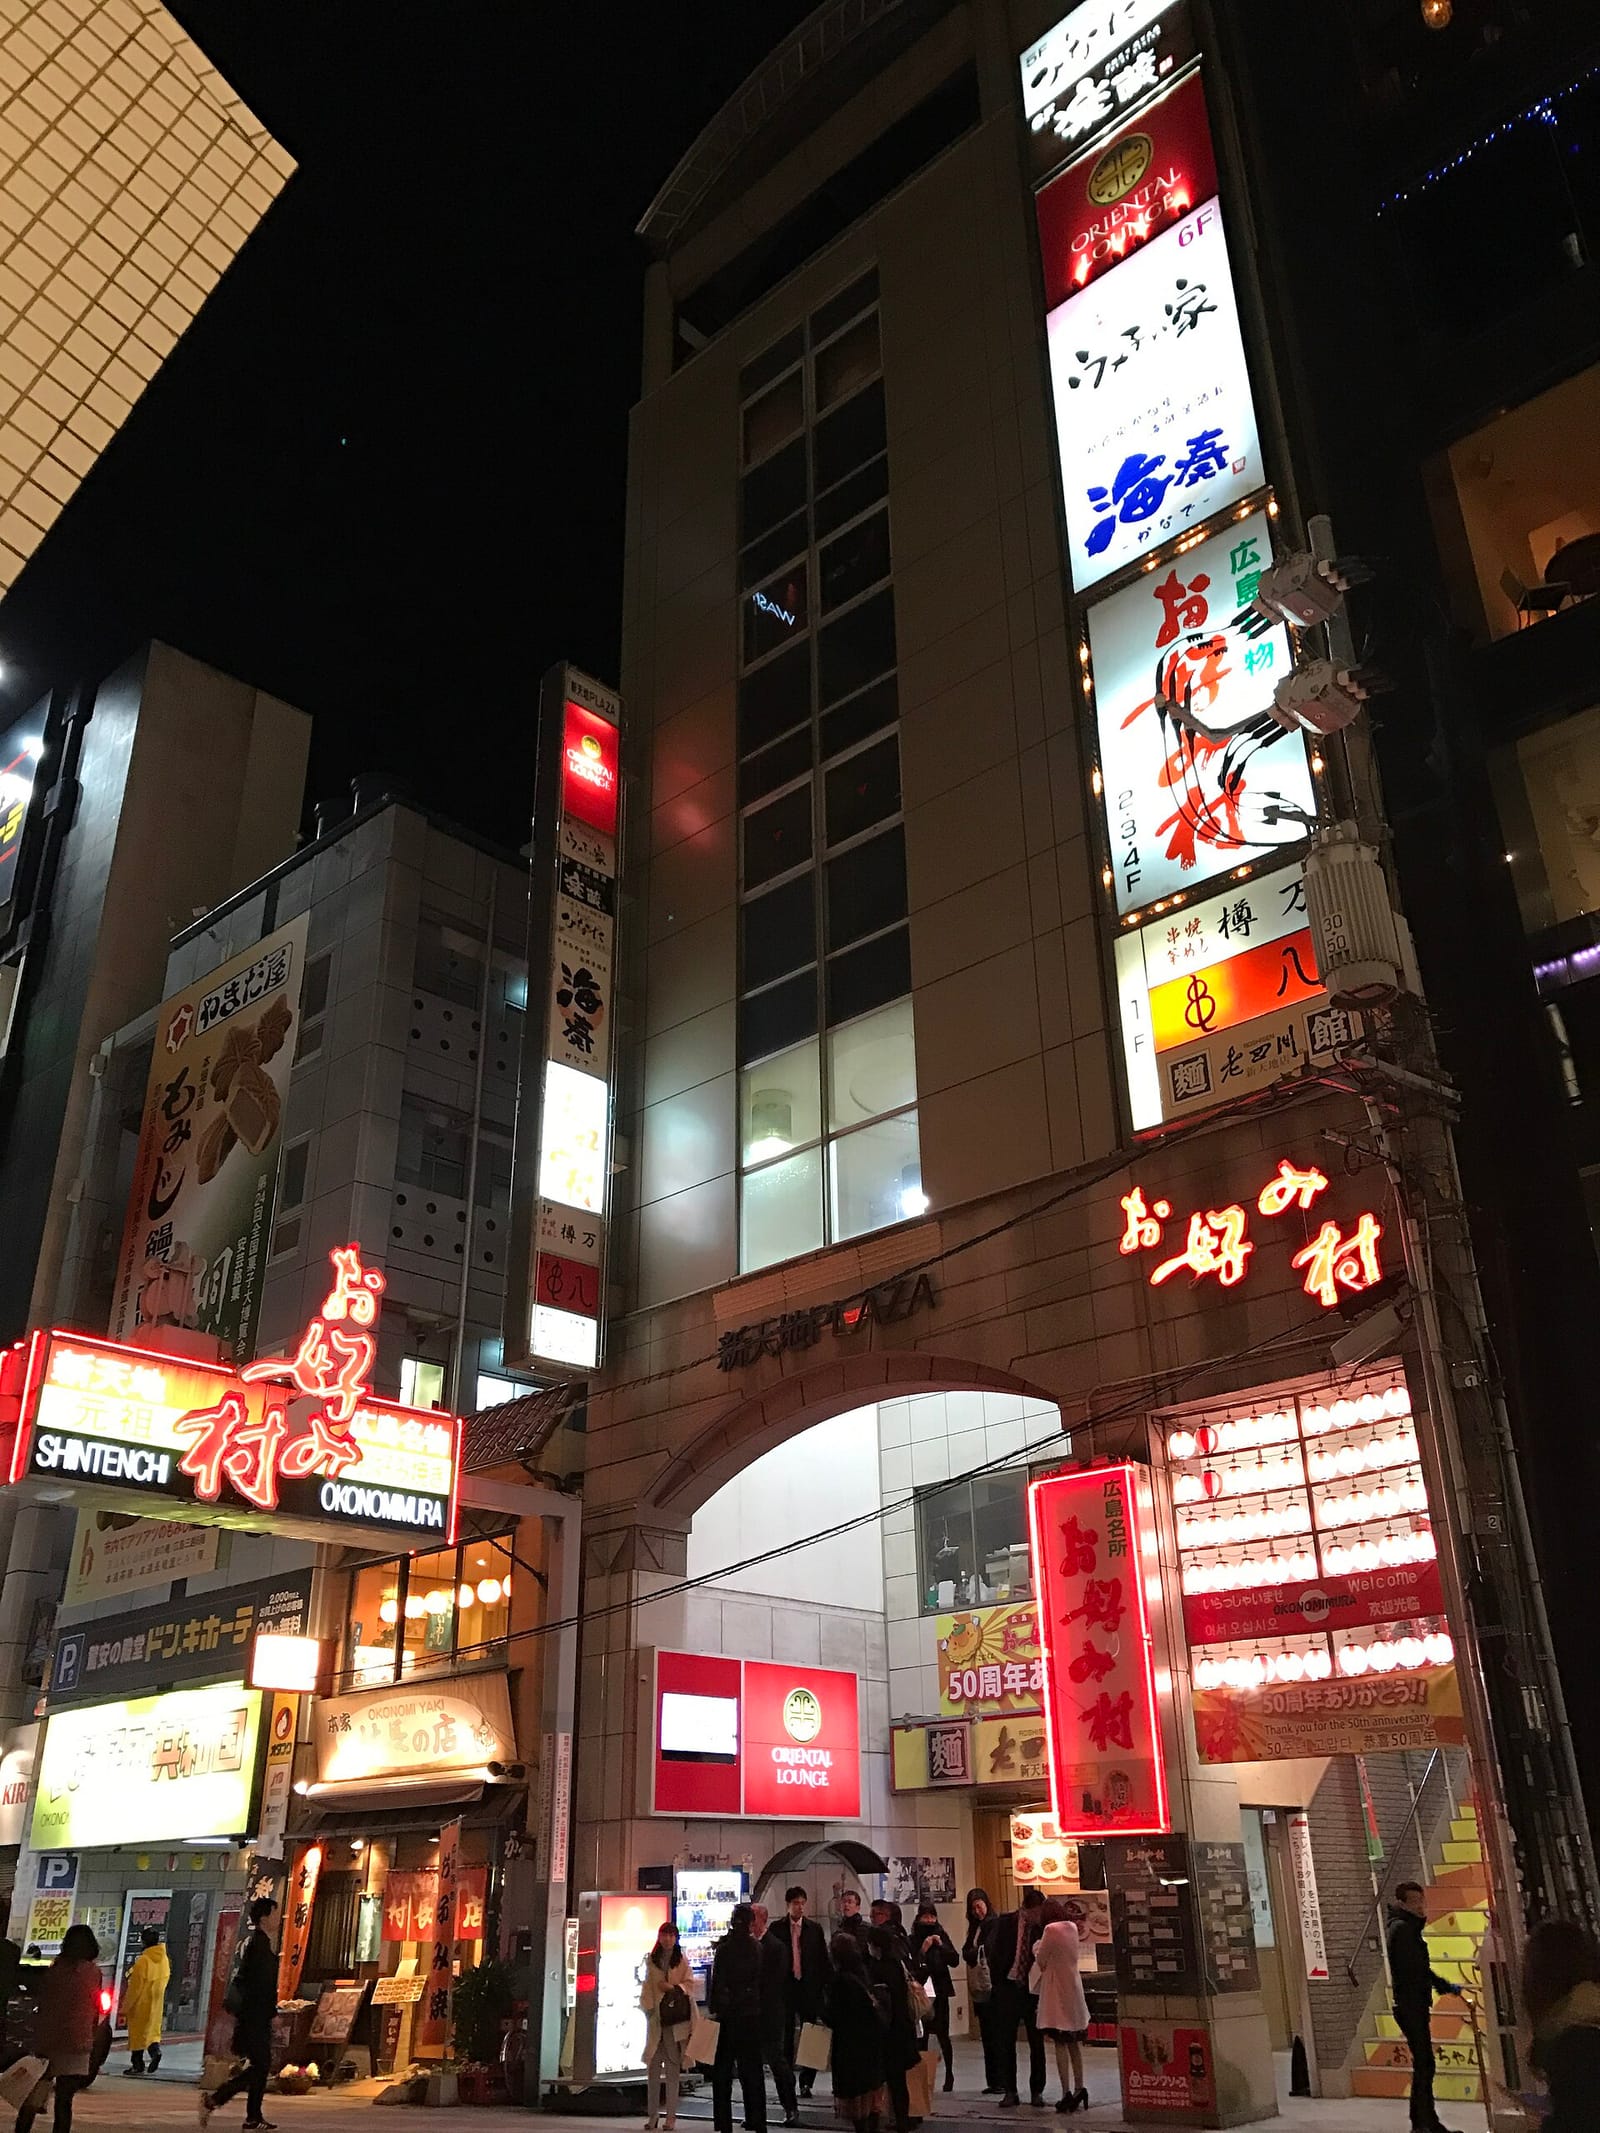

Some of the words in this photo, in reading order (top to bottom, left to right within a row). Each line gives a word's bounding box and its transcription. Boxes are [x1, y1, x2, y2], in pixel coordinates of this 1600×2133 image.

[1071, 168, 1181, 253] ORIENTAL
[1178, 207, 1214, 247] 6F
[1230, 537, 1275, 677] 広島物
[1118, 1158, 1382, 1308] お好み村
[1104, 1480, 1127, 1557] 広島名所
[1202, 1589, 1284, 1611] いらっしゃいませ
[1273, 1595, 1357, 1615] OKONOMIMURA
[1058, 1515, 1135, 1752] お好み村
[368, 1706, 417, 1721] OKONOMI
[419, 1699, 445, 1716] YAKI
[1264, 1724, 1293, 1736] Thank
[1295, 1722, 1312, 1735] you
[1314, 1720, 1327, 1731] for
[1330, 1719, 1345, 1730] the
[1348, 1716, 1370, 1728] 50th
[771, 1747, 833, 1767] ORIENTAL
[777, 1769, 830, 1788] LOUNGE
